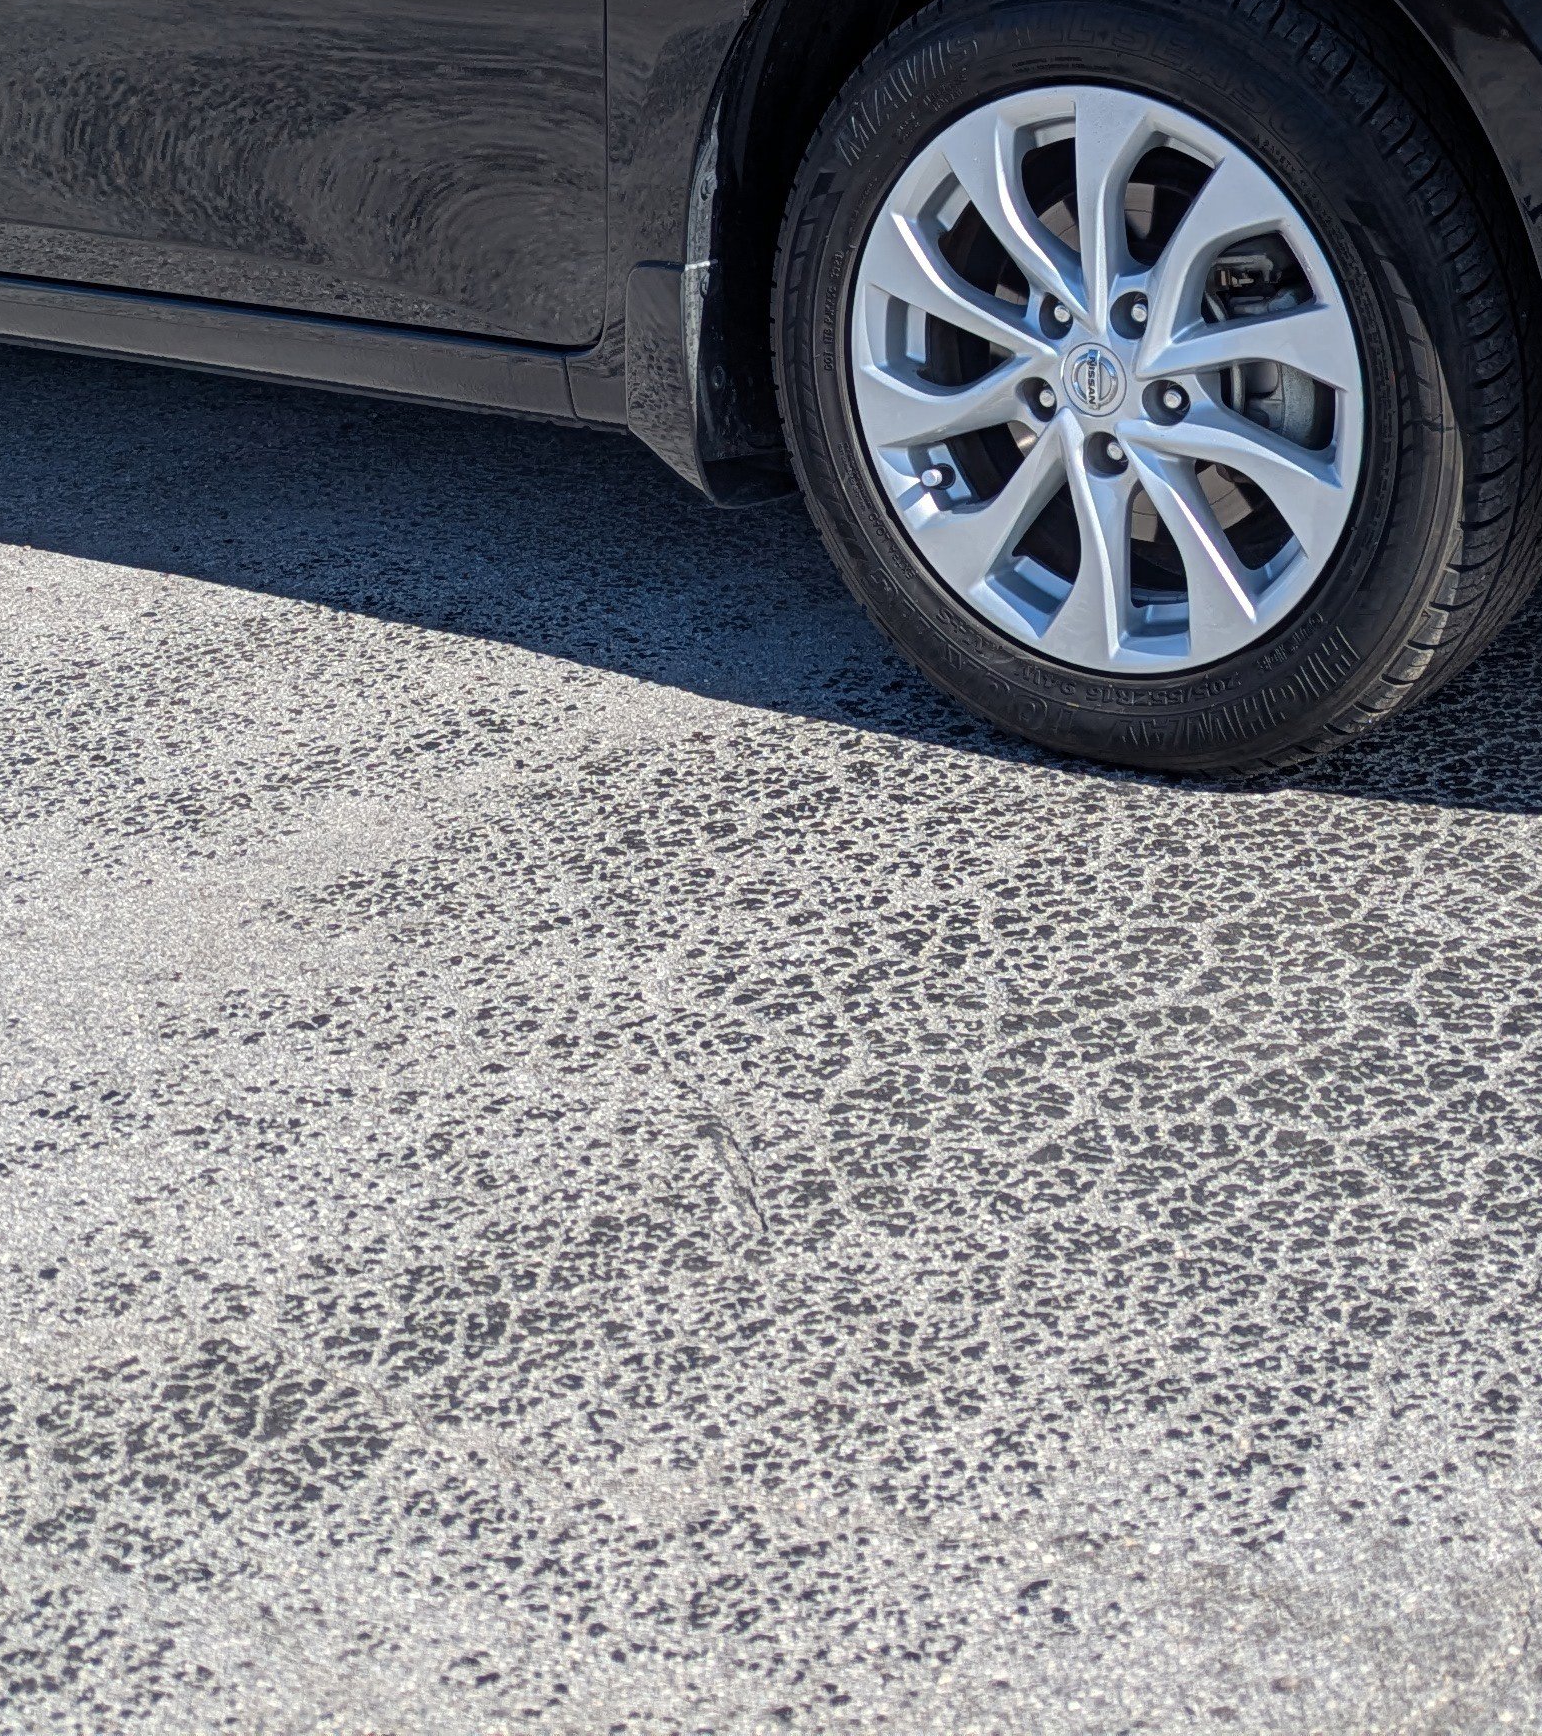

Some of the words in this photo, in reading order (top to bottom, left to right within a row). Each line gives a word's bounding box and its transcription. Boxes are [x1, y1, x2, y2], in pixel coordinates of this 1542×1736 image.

[836, 34, 979, 167] MAVIS
[1087, 356, 1097, 405] NISSAN
[1111, 625, 1361, 752] HIGHWAY
